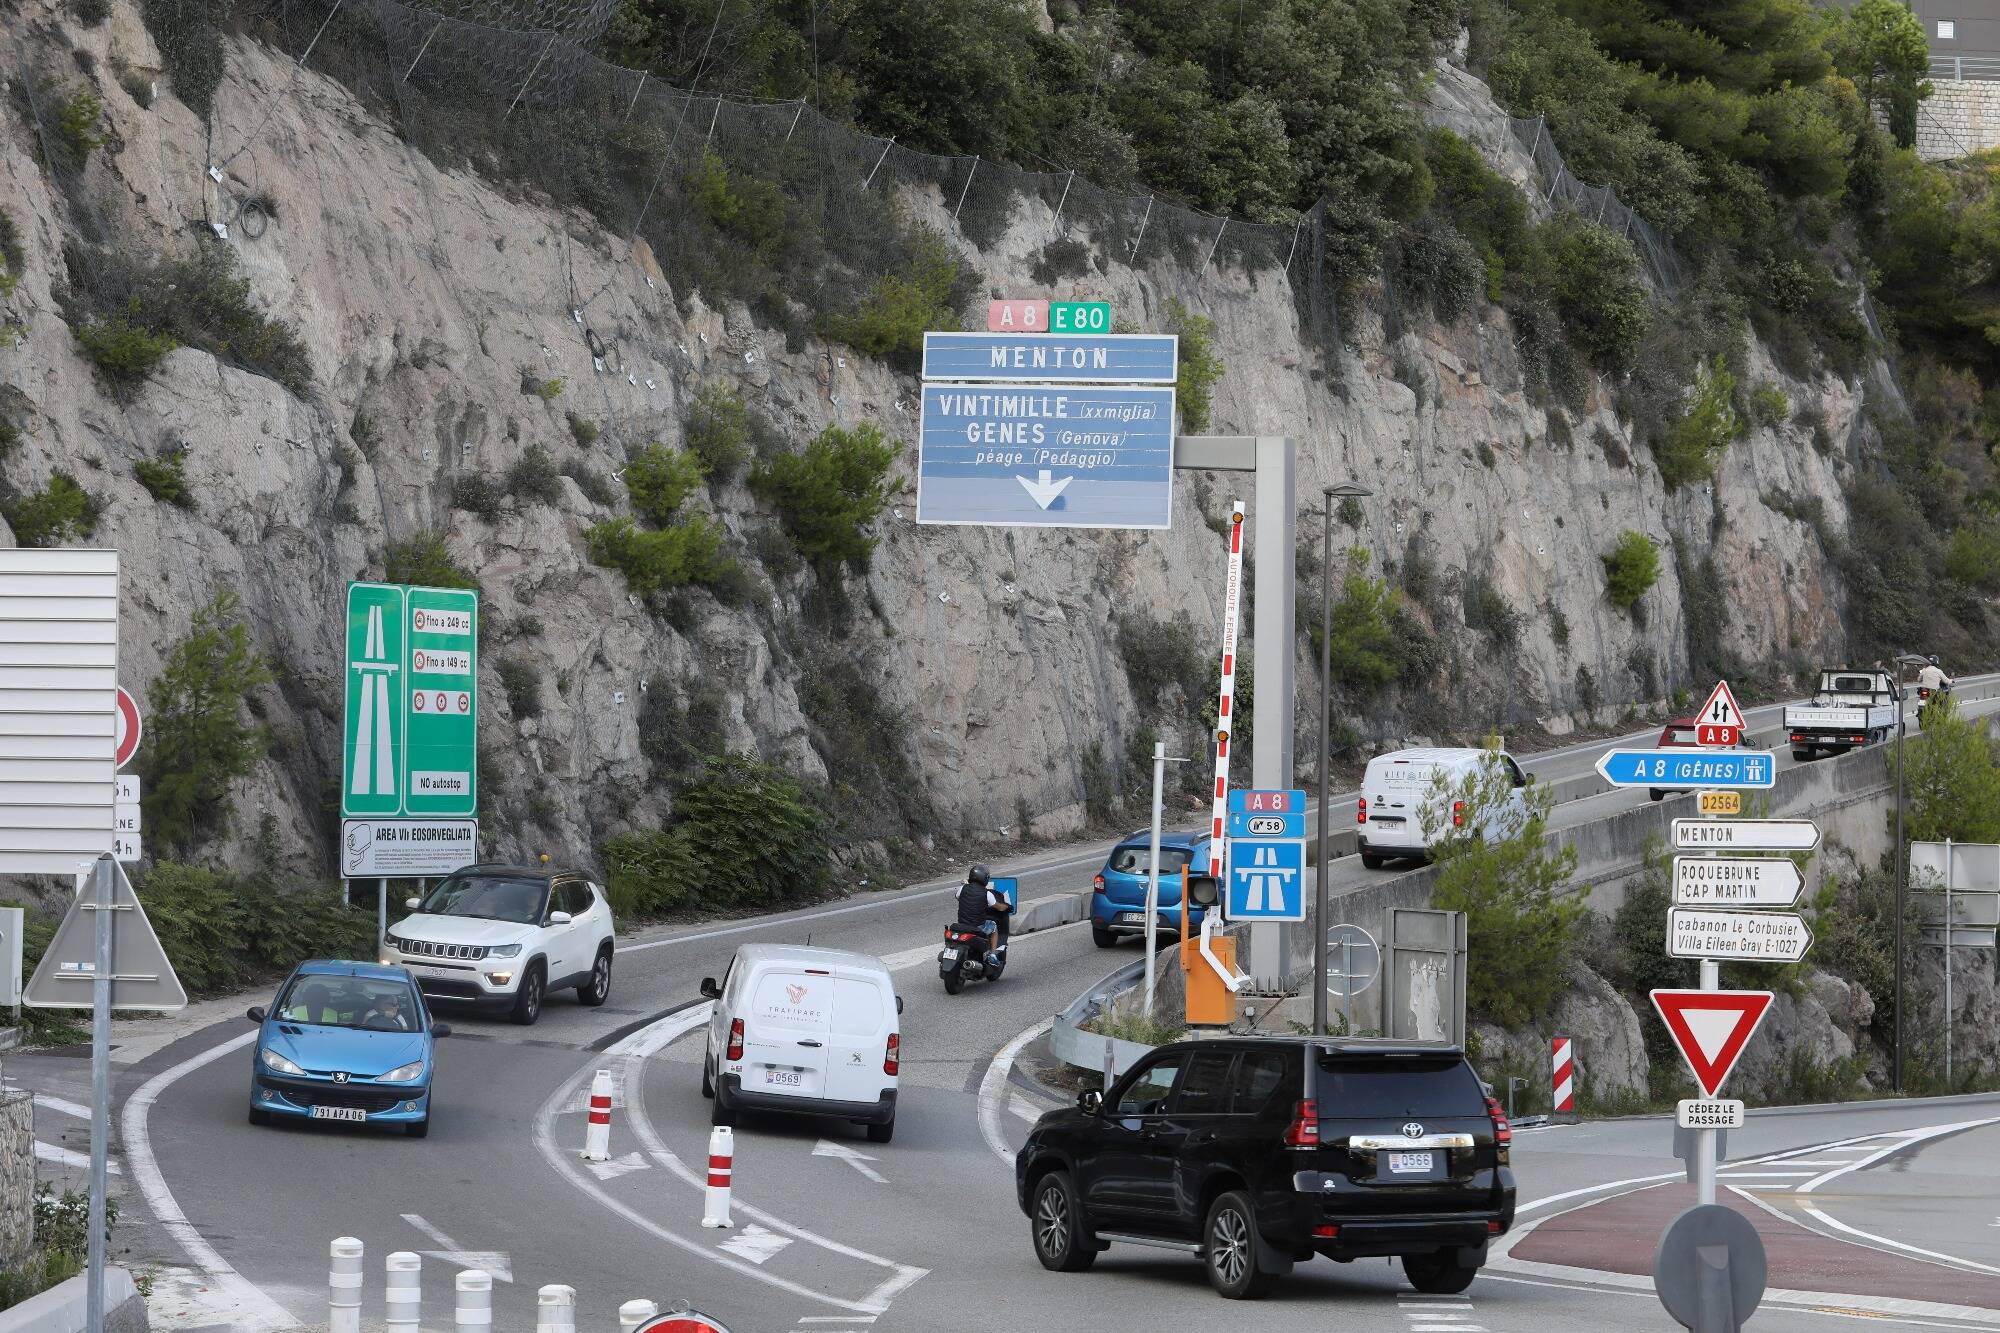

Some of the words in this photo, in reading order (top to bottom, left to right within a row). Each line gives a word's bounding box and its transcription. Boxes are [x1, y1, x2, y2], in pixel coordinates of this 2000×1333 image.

[991, 346, 1107, 368] MENTON
[940, 394, 1068, 418] VINTIMILLE
[967, 422, 1045, 444] GENES
[1056, 430, 1127, 446] (Genova)
[976, 448, 1023, 467] péage
[1034, 448, 1116, 468] (Pedaggio)
[1228, 558, 1238, 612] AUTOROUTE
[440, 619, 444, 628] a
[448, 616, 460, 628] 249
[1225, 618, 1234, 652] FERMEE
[440, 659, 444, 668] a
[447, 656, 458, 668] 149
[1675, 760, 1740, 780] (GÊNES)
[420, 778, 430, 788] NO
[432, 778, 461, 792] autostop
[1266, 822, 1280, 830] 58
[376, 828, 396, 841] AREA
[1680, 828, 1732, 841] MENTON
[1681, 866, 1760, 880] ROQUEBRUNE
[1716, 884, 1756, 898] MARTIN
[1678, 918, 1727, 932] cabanon
[1732, 919, 1742, 933] Le
[1748, 920, 1798, 936] Corbusier
[1678, 934, 1702, 949] Villa
[1706, 936, 1737, 951] Eileen
[1740, 938, 1762, 954] Gray
[1766, 939, 1798, 954] E-1027
[776, 1074, 799, 1084] 0569
[1688, 1104, 1721, 1114] CÉDEZ
[1724, 1104, 1735, 1114] LE
[1688, 1116, 1735, 1124] PASSAGE
[1402, 1154, 1430, 1166] 0566
